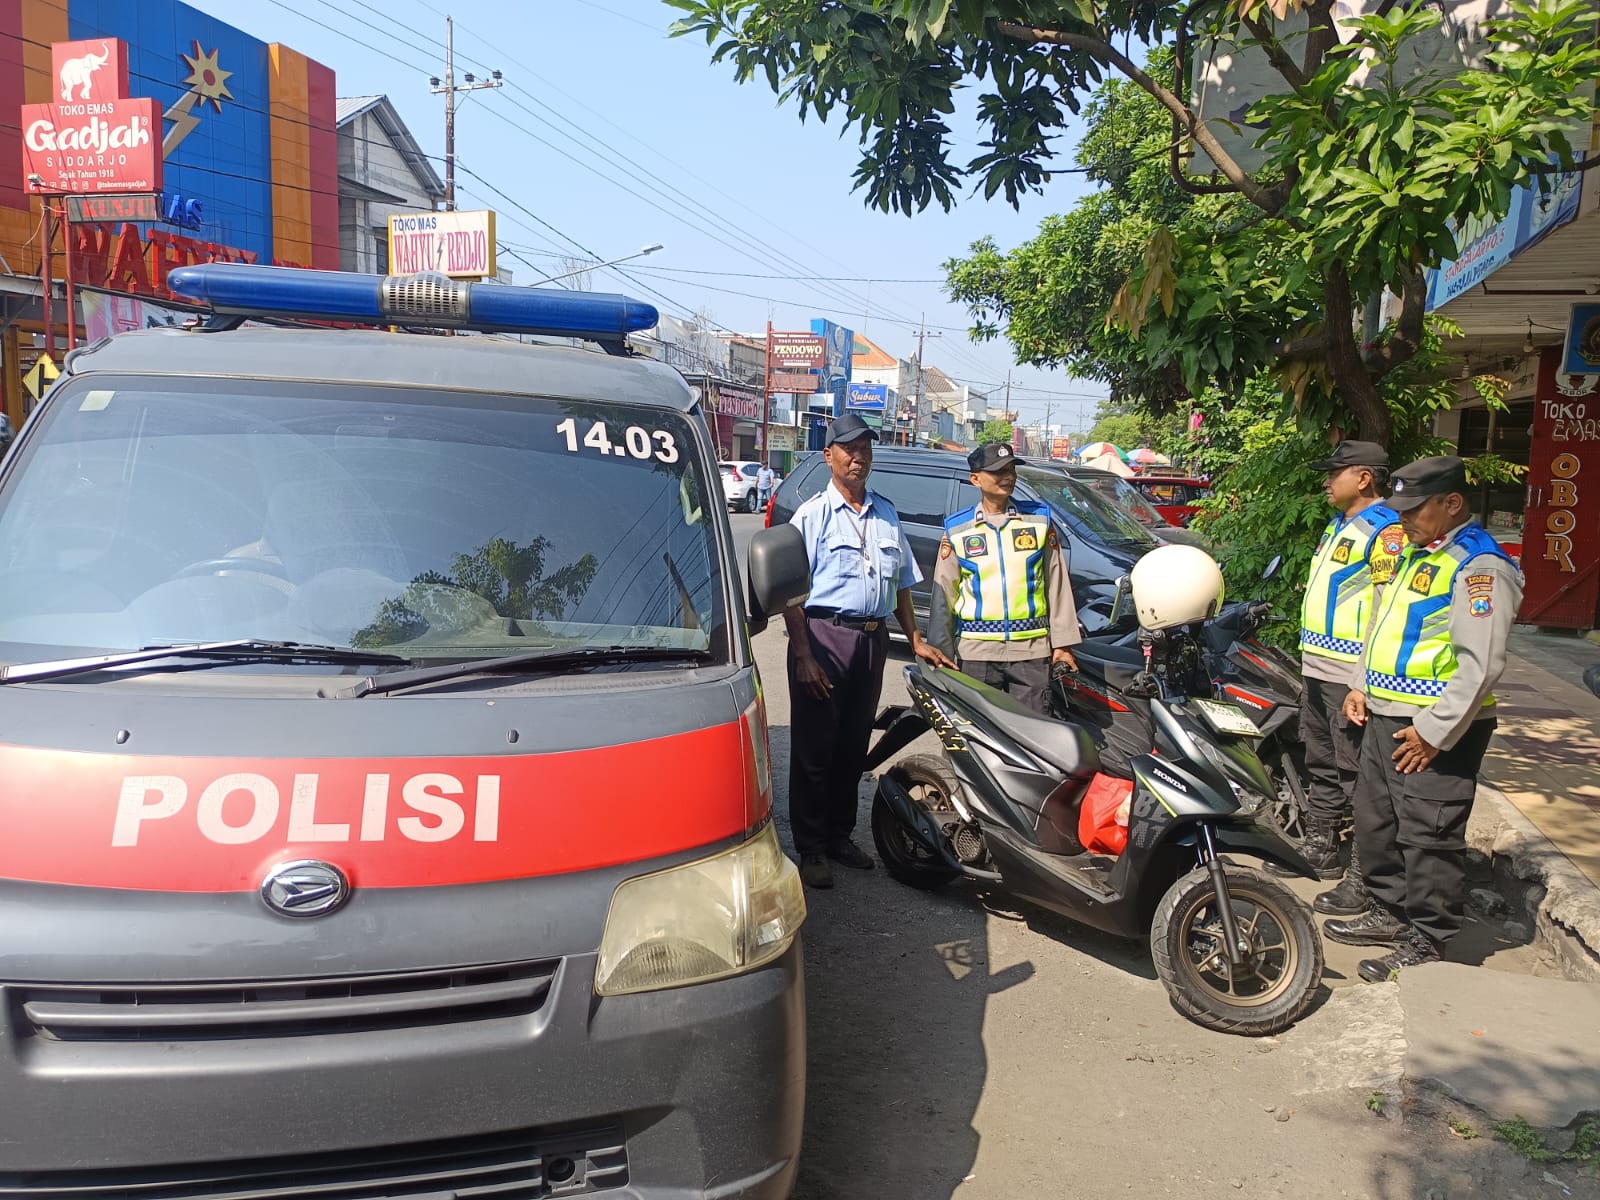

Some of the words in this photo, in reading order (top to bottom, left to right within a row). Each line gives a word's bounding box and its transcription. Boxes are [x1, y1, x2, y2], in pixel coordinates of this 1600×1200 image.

[59, 105, 85, 115] TOKO
[87, 103, 114, 114] EMAS
[25, 116, 150, 154] Gadjah
[46, 154, 127, 168] SIDOARJO
[77, 170, 97, 179] Tahun
[99, 169, 115, 178] 1918
[393, 218, 416, 231] TOKO
[418, 216, 437, 230] MAS
[393, 233, 434, 274] WAHYU
[447, 230, 487, 272] REDJO
[773, 345, 822, 354] PENDOWO
[850, 389, 884, 405] Subur
[1541, 400, 1586, 419] TOKO
[556, 418, 679, 464] 14.03
[1543, 453, 1581, 573] OBOR
[1236, 696, 1263, 710] HONDA
[1152, 768, 1188, 793] HONDA
[112, 773, 501, 847] POLISI
